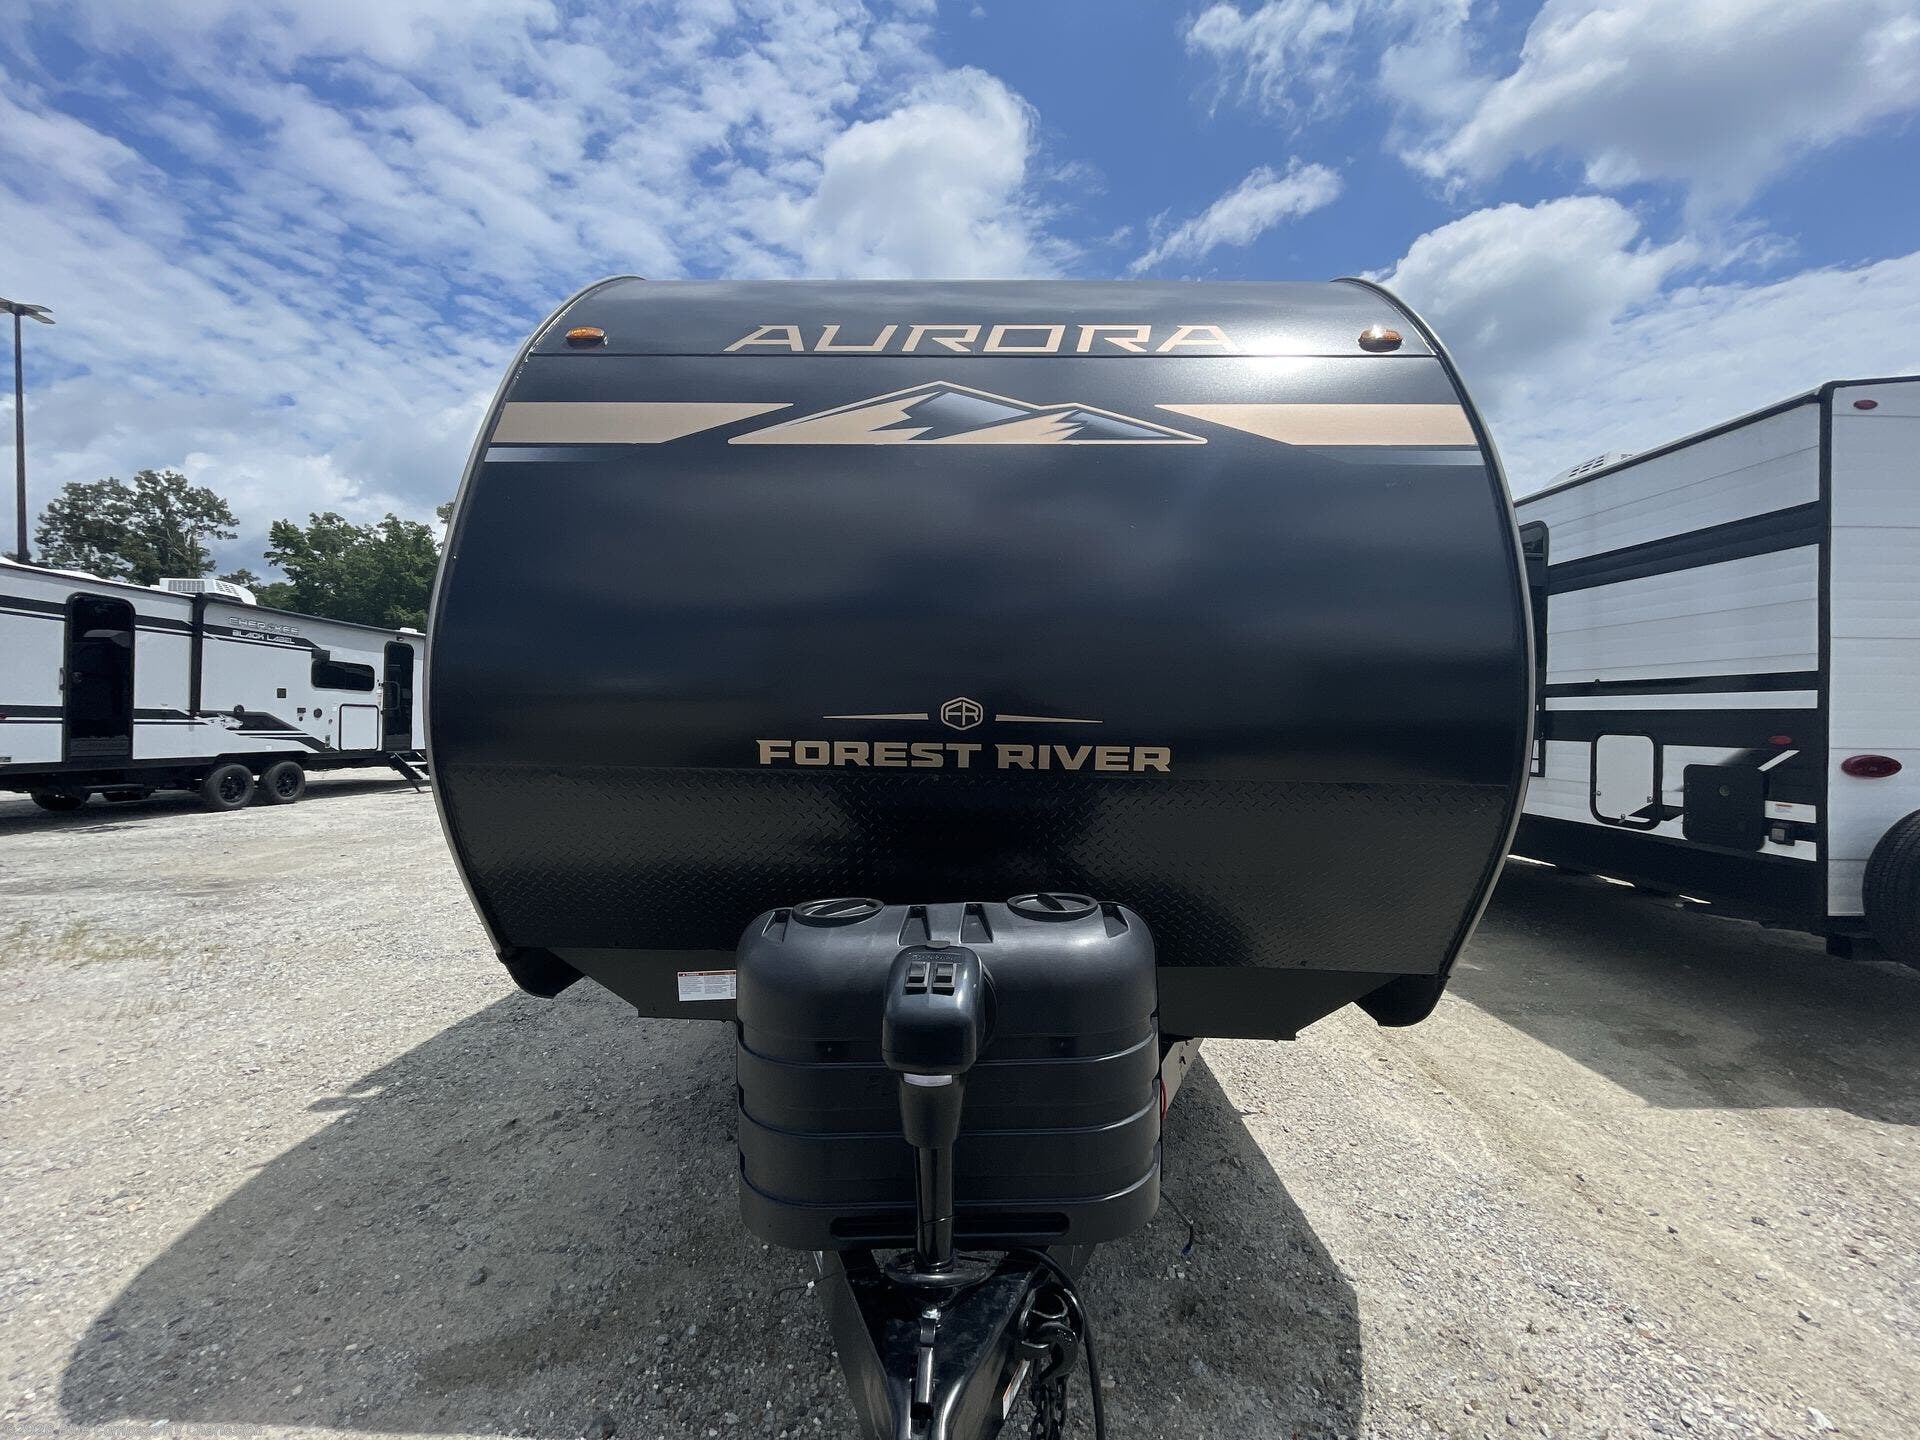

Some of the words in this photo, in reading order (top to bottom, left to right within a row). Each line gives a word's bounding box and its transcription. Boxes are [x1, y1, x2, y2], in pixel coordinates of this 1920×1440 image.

[723, 324, 1233, 352] AURORA
[232, 629, 265, 640] BLACK
[755, 740, 983, 769] FOREST
[994, 743, 1172, 772] RIVER
